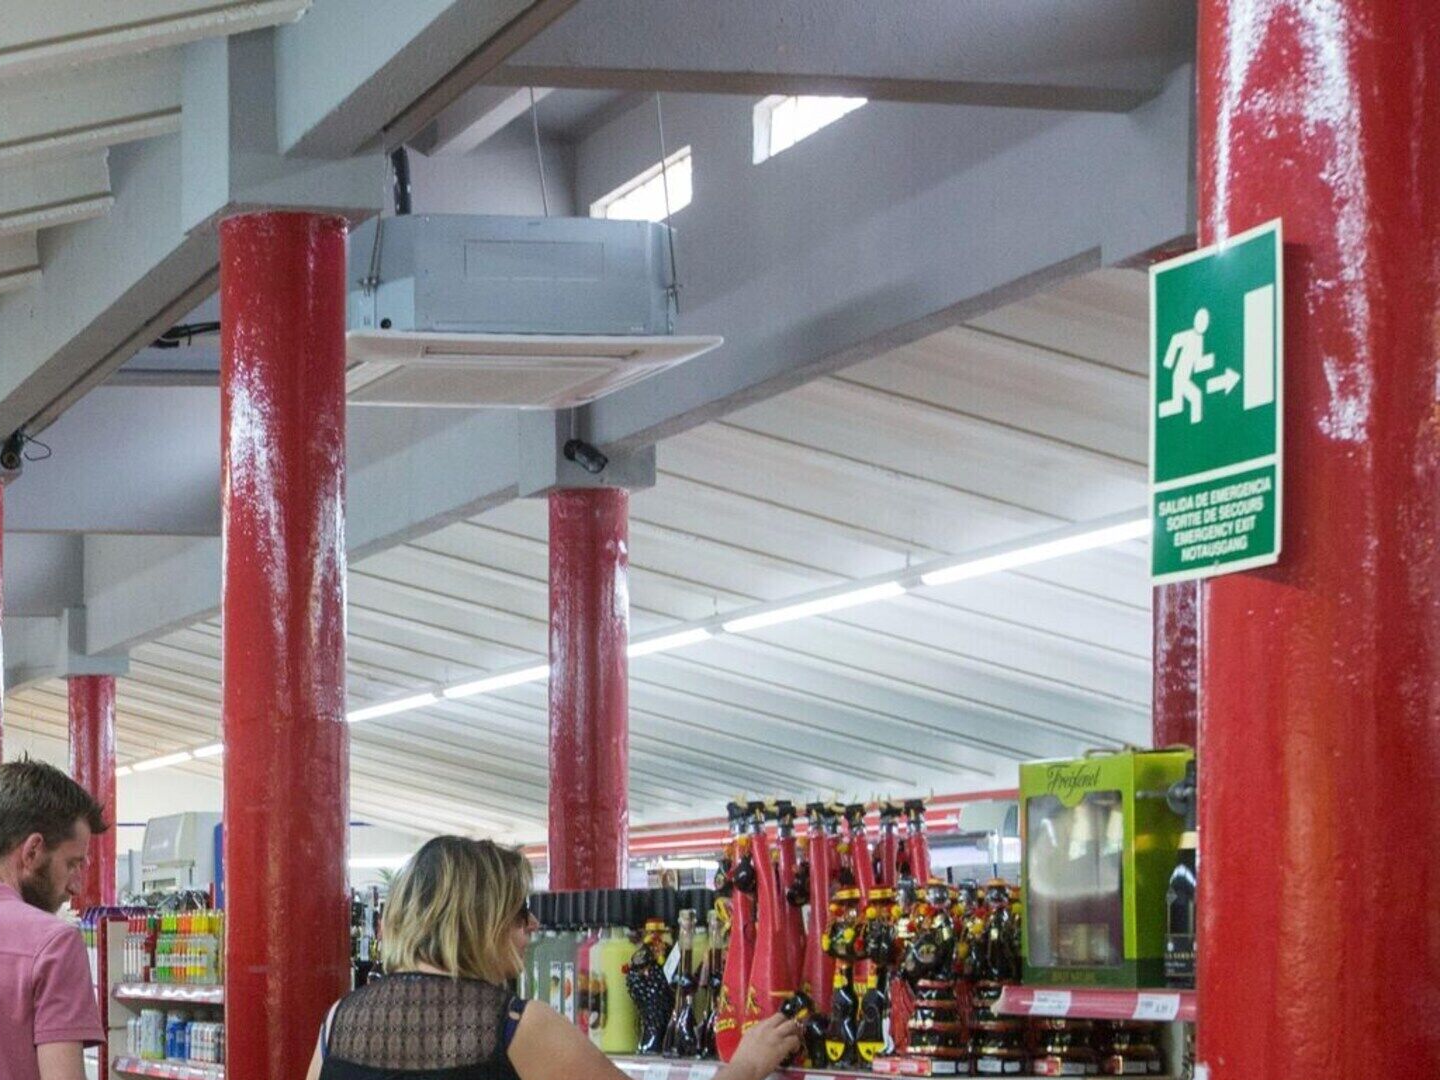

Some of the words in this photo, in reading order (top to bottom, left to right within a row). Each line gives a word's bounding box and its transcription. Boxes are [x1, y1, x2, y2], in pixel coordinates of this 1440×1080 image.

[1159, 495, 1193, 516] SALIDA
[1195, 491, 1209, 508] DE
[1210, 477, 1271, 504] EMERGENCIA
[1166, 510, 1202, 531] SORTIE
[1203, 506, 1217, 523] DE
[1219, 495, 1264, 520] SECOURS
[1174, 521, 1234, 547] EMERGENCY
[1235, 515, 1256, 533] EXIT
[1181, 535, 1248, 562] NOTAUSGANG
